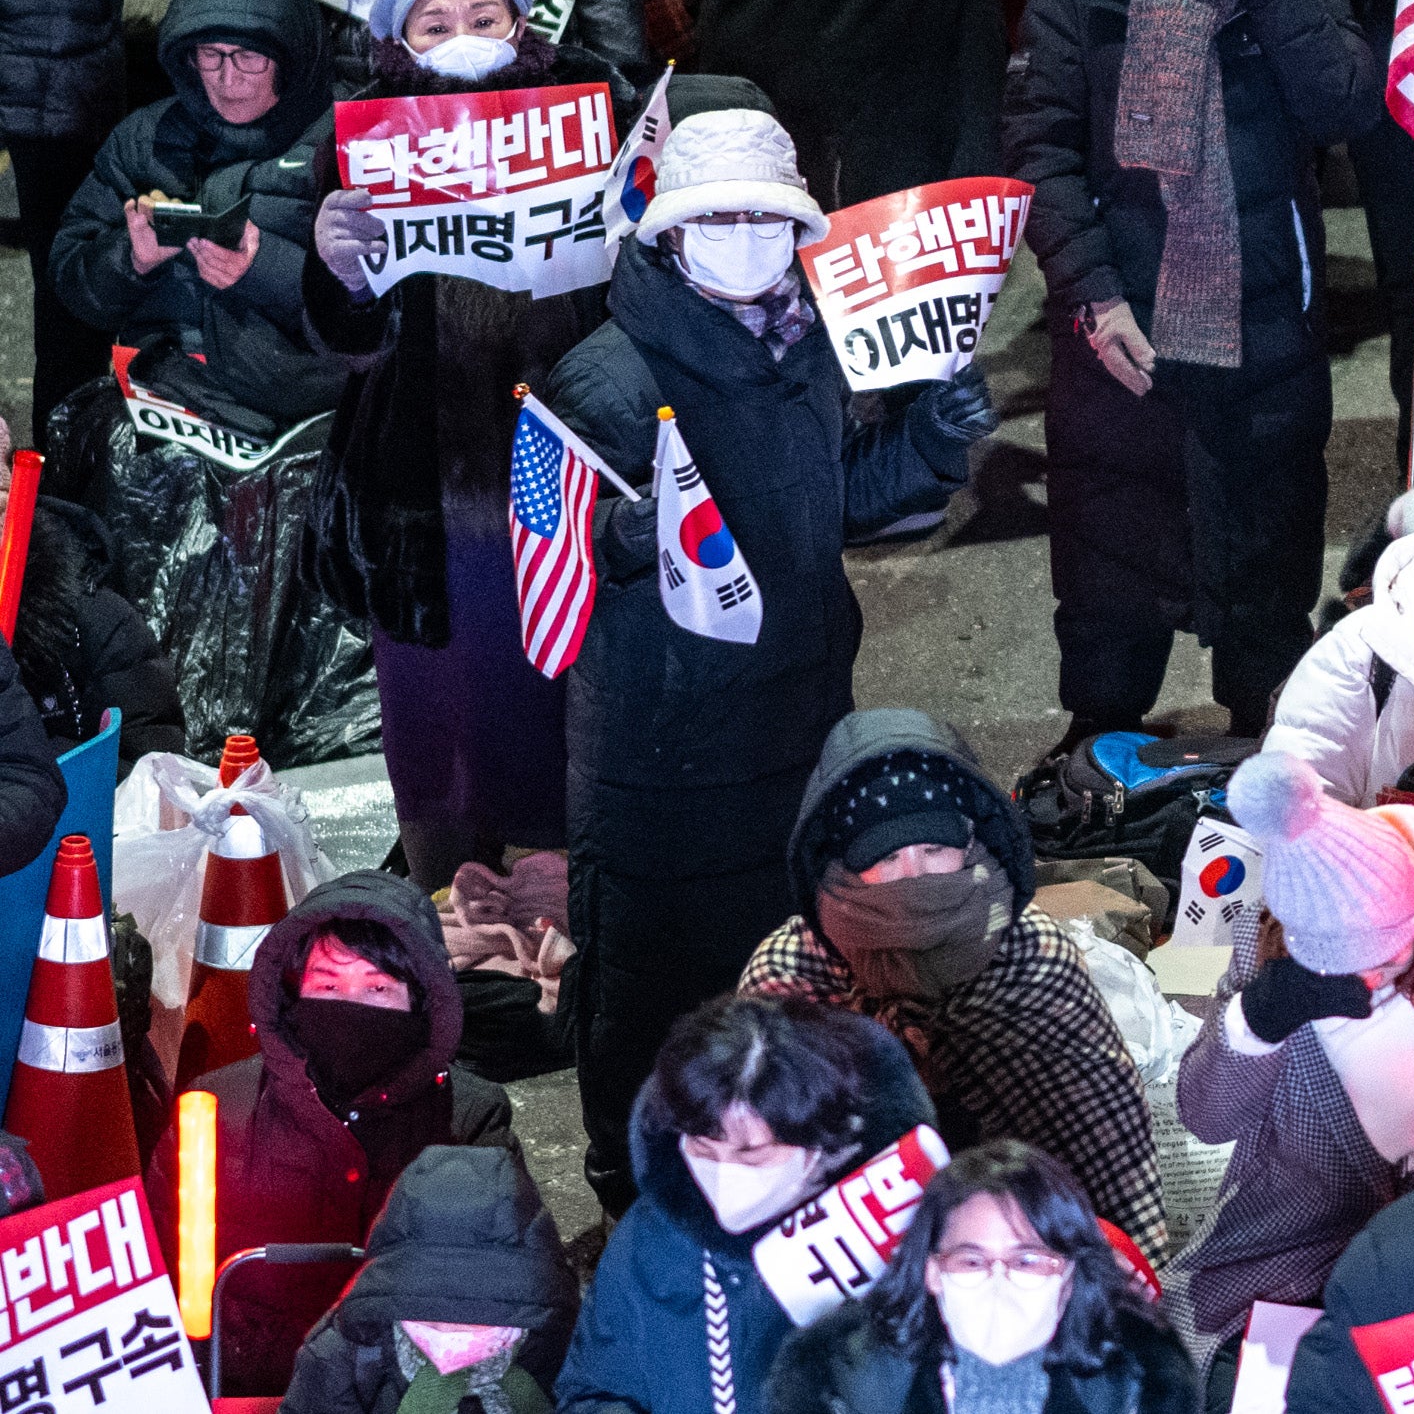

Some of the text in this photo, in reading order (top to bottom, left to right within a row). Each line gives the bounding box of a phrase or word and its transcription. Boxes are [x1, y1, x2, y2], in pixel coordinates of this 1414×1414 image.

[348, 91, 610, 203] 탄핵반대
[0, 1189, 152, 1344] 반대
[60, 1308, 183, 1406] 구속
